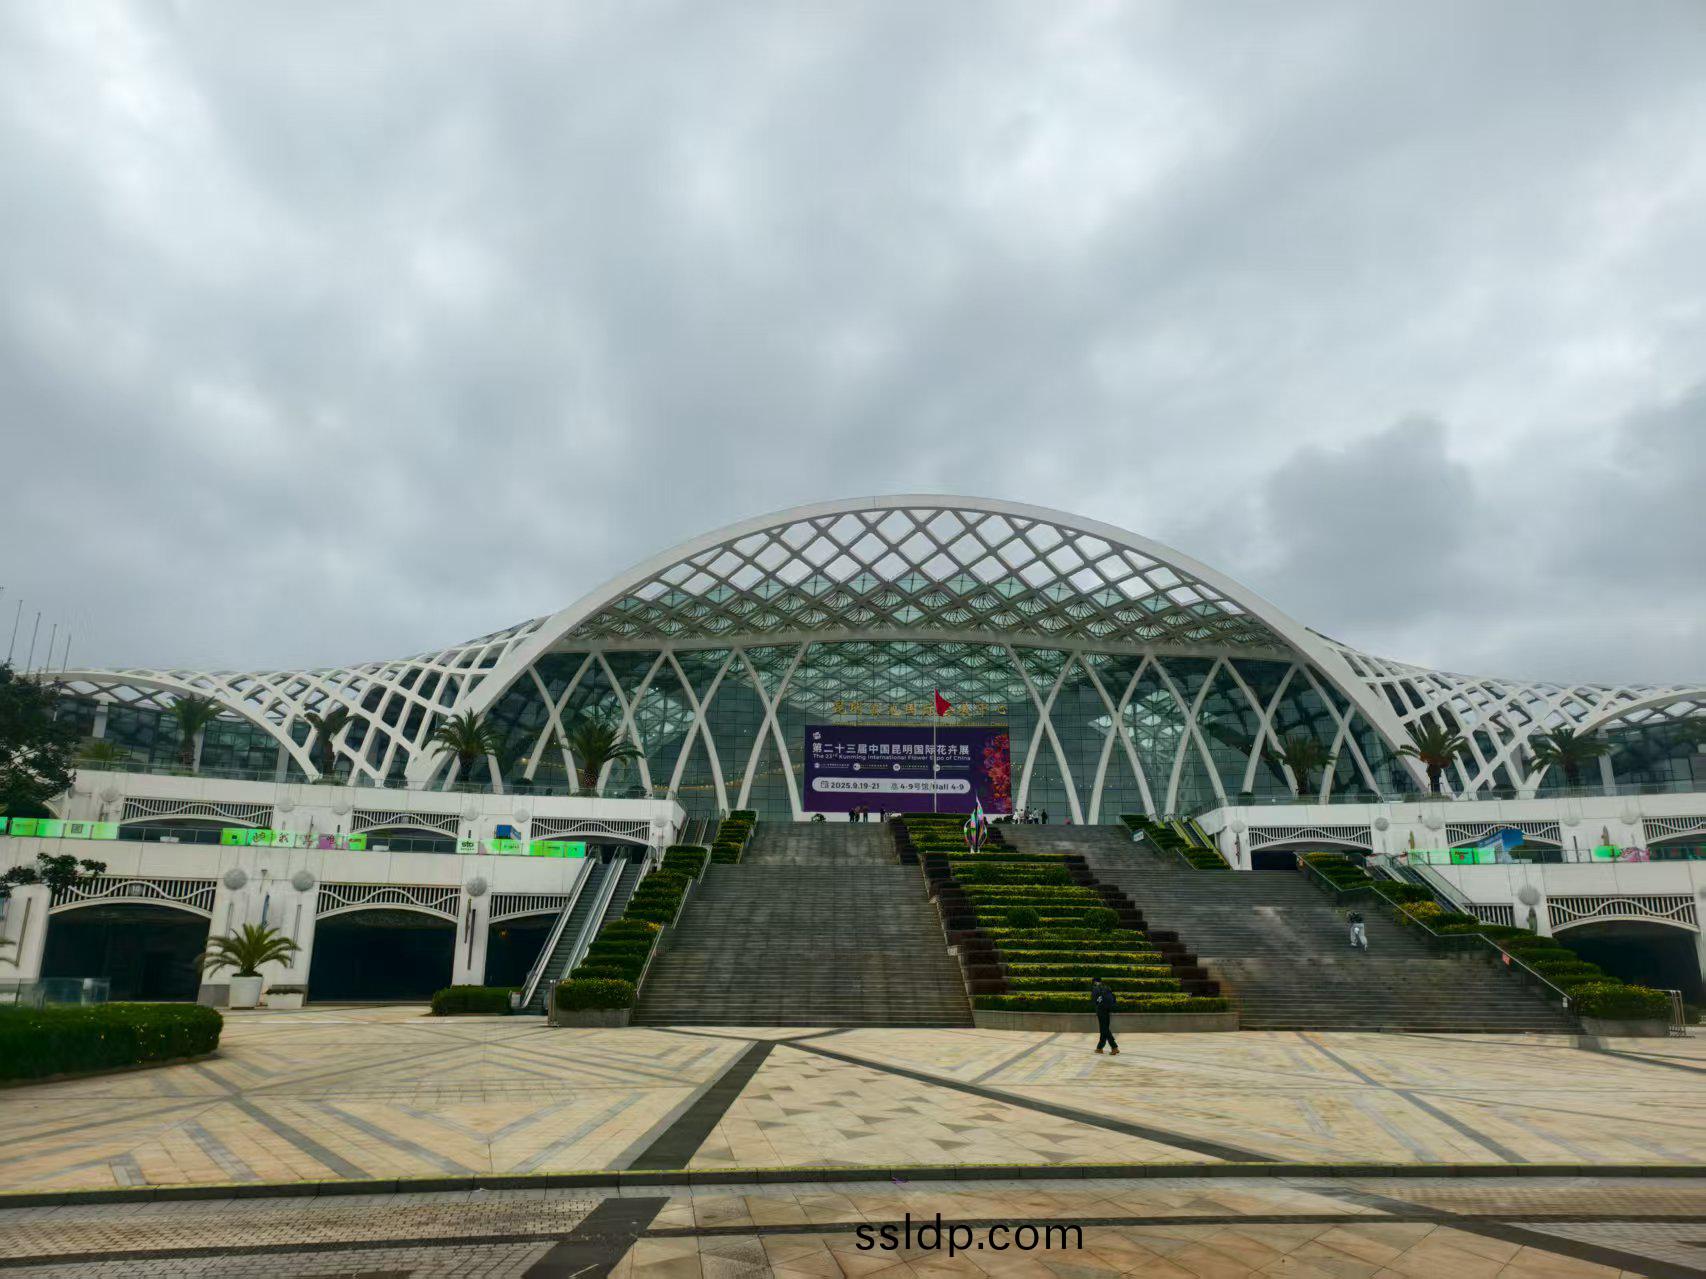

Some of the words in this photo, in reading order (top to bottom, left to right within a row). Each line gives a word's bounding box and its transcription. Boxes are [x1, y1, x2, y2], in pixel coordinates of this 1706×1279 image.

[812, 742, 970, 755] 第二十三届中国昆明国际花卉展
